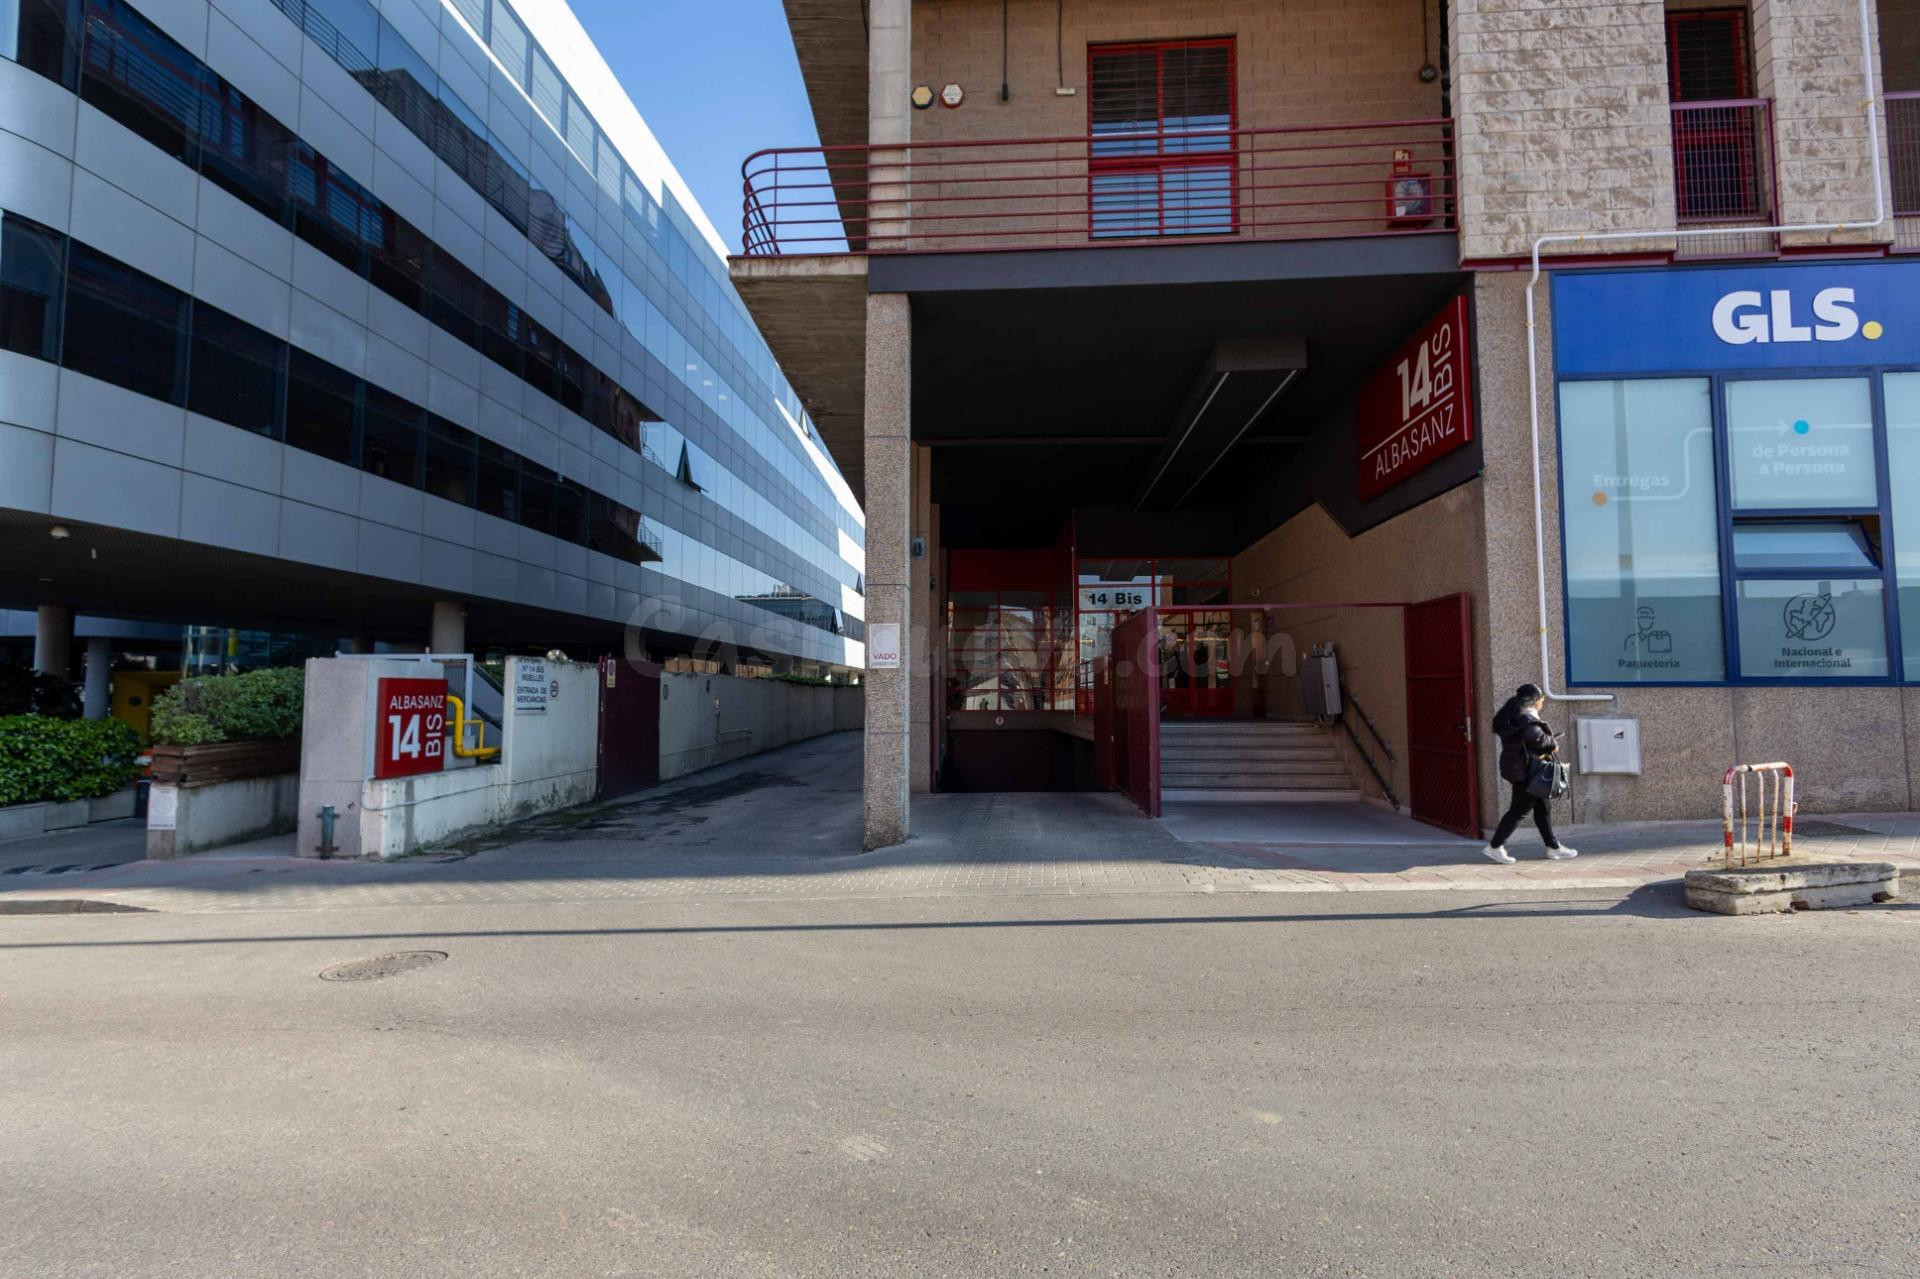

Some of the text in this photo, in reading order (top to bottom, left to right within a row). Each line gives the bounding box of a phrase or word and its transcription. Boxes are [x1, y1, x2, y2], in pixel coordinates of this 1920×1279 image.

[1432, 322, 1453, 397] BIS
[1396, 340, 1432, 422] 14
[1375, 402, 1456, 480] ALBASANZ
[1752, 443, 1850, 459] de Persona
[1759, 460, 1846, 476] a Persona
[1593, 474, 1670, 491] Entregas
[1088, 592, 1143, 605] 14 Bis
[1781, 647, 1843, 657] Nacional e
[1774, 659, 1852, 669] Internacional
[516, 686, 539, 694] ENTRADA
[389, 695, 444, 710] ALBASANZ
[388, 713, 421, 761] 14
[425, 713, 443, 757] BIS
